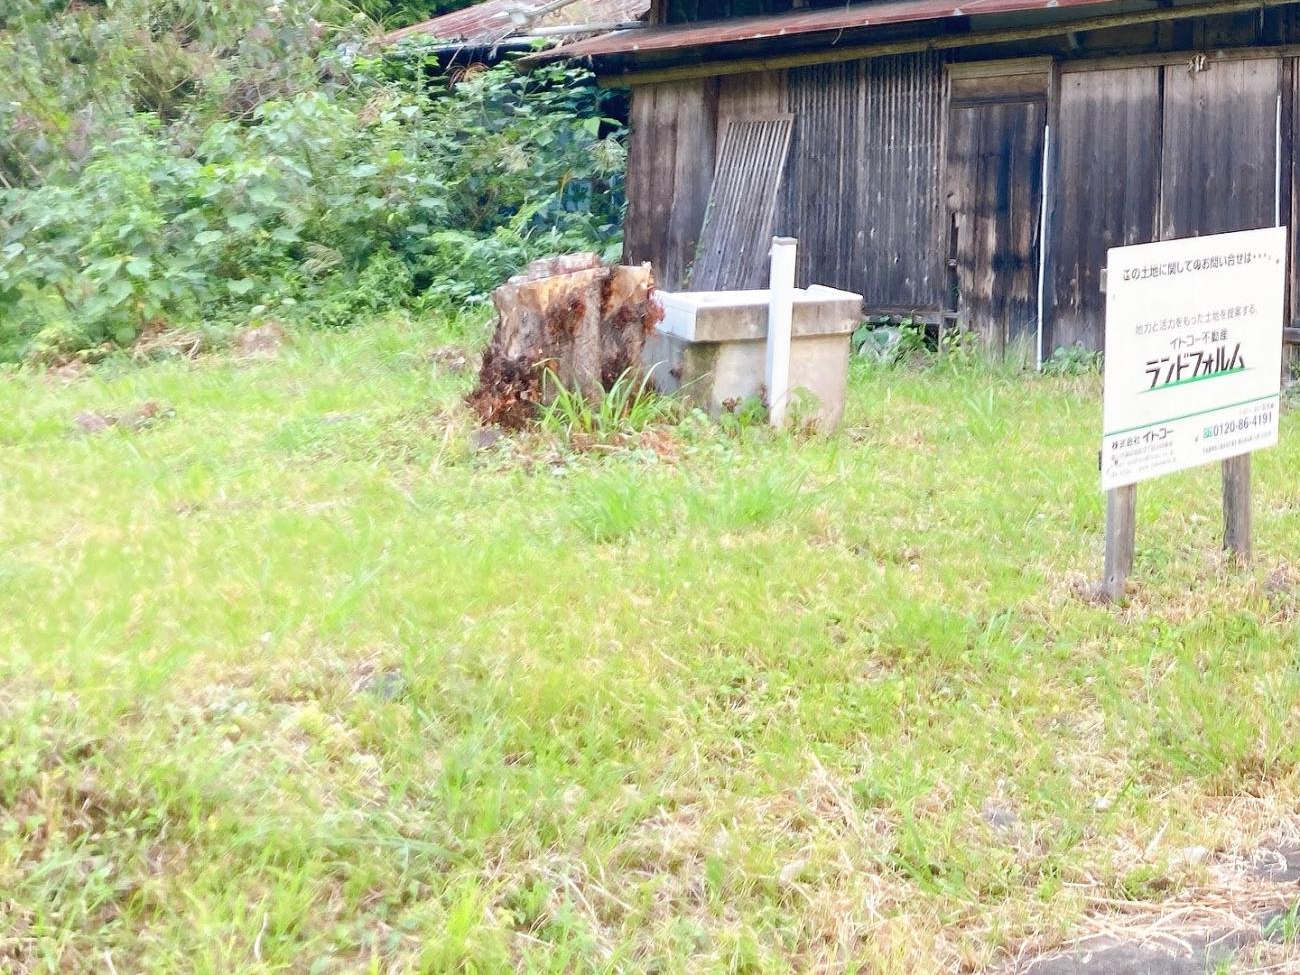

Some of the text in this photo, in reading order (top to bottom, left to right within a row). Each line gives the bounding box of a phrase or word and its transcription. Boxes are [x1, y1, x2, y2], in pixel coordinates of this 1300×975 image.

[1169, 328, 1229, 351] イトコー不動産
[1145, 342, 1246, 389] ランドフォルム
[1213, 411, 1273, 437] 0120-86-4191
